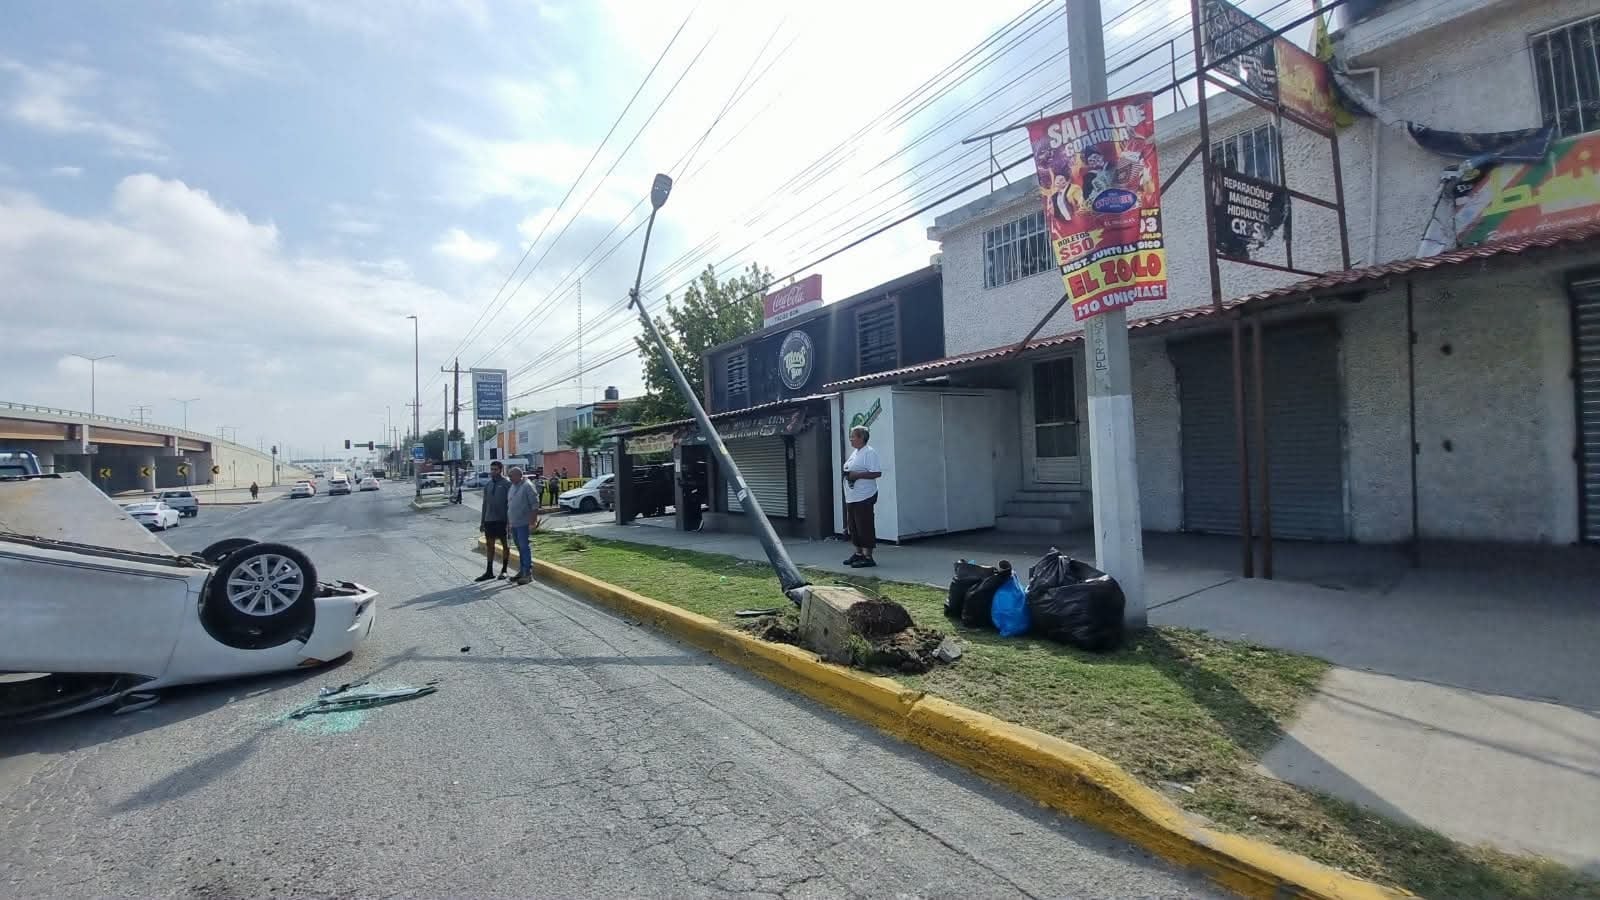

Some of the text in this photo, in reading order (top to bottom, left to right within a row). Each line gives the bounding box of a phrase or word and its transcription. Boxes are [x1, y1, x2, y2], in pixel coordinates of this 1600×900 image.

[1057, 232, 1090, 247] BOLETOS
[1059, 237, 1095, 261] $50
[1123, 244, 1137, 253] AL
[1068, 270, 1100, 299] EL
